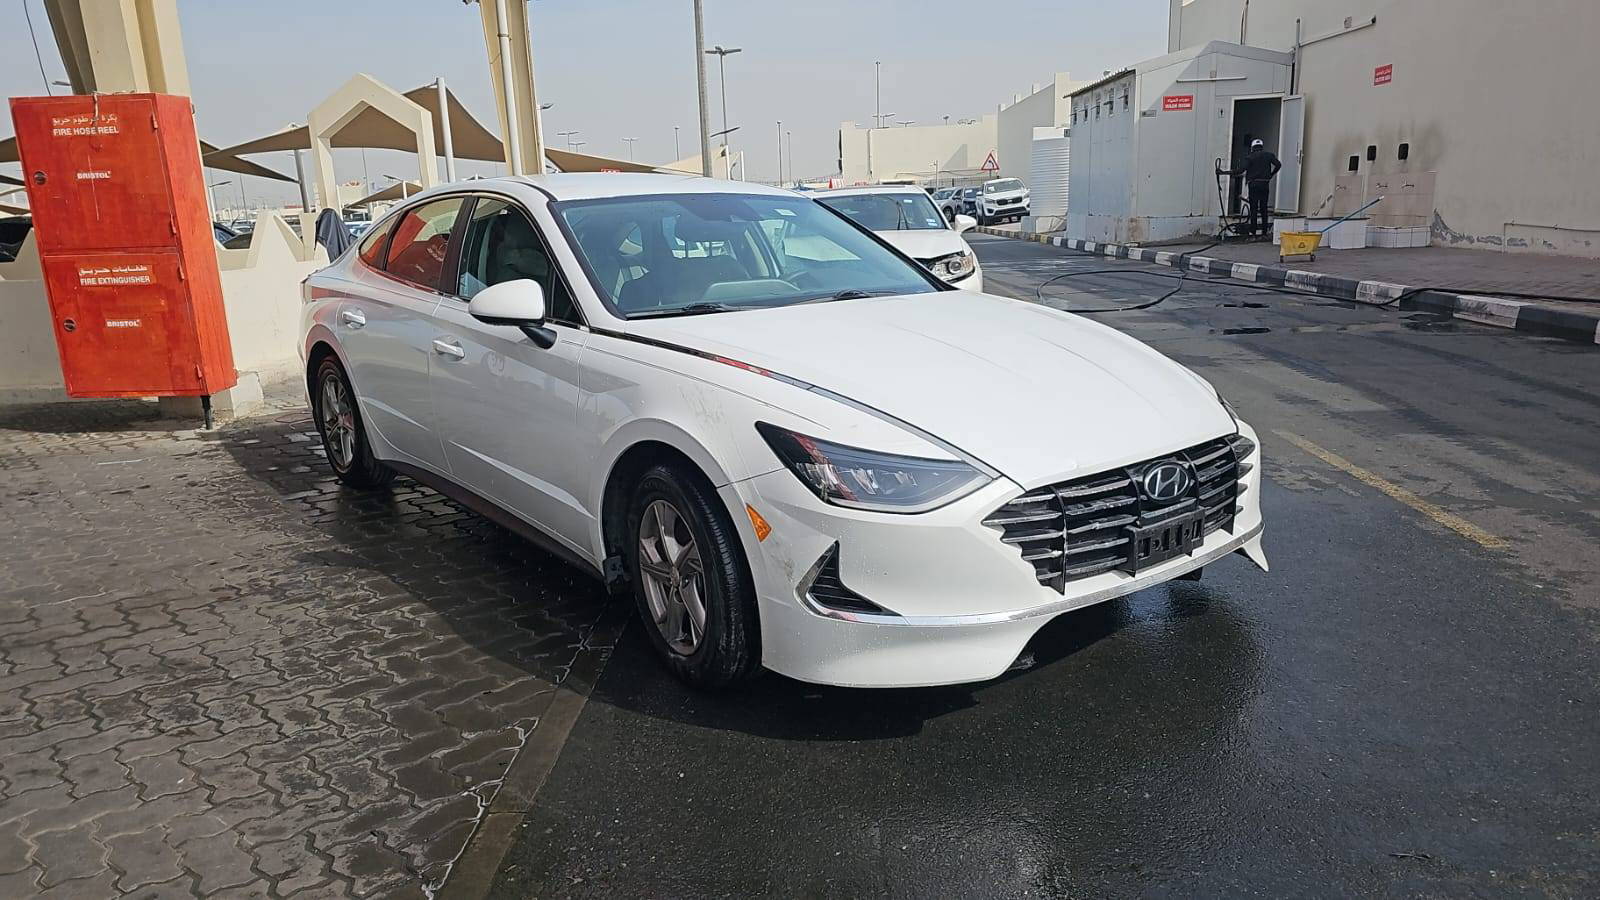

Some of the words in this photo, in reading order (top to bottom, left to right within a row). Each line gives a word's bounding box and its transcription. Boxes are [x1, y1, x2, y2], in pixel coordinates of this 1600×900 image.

[53, 127, 73, 137] FIRE
[73, 127, 97, 136] HOSE
[97, 125, 120, 135] REEL
[80, 277, 97, 287] FIRE
[97, 274, 151, 286] EXTINGUISHER
